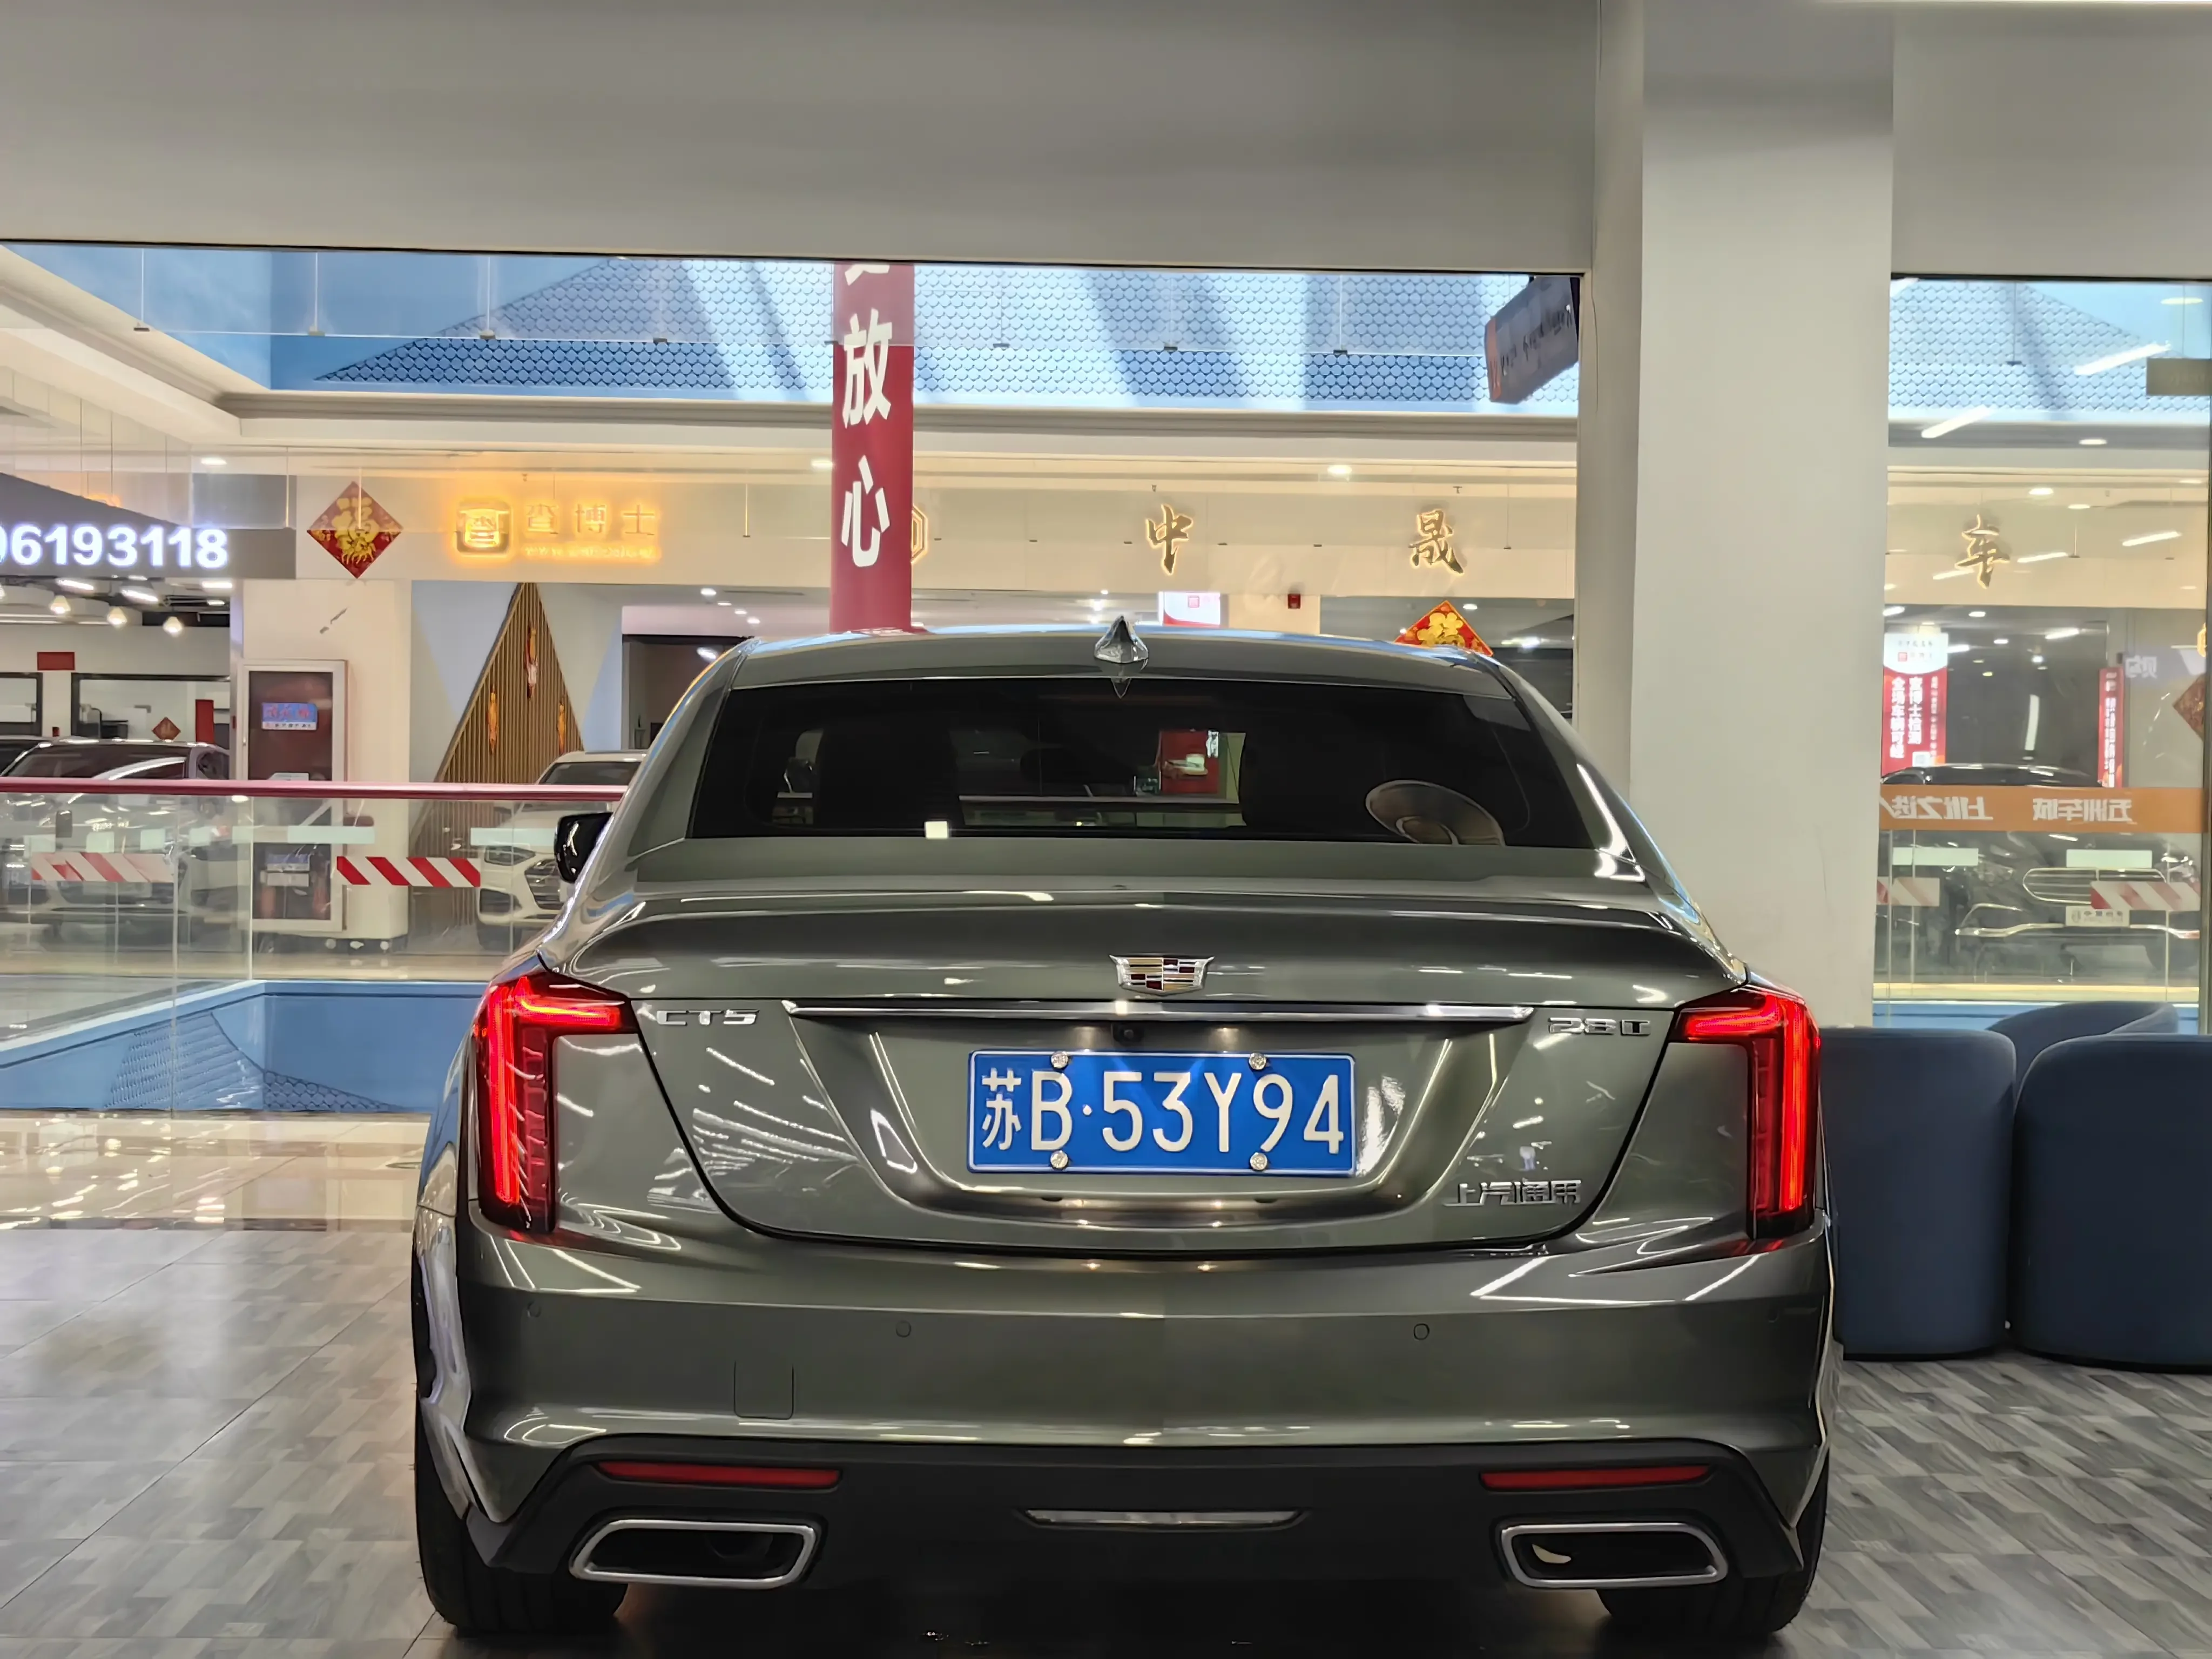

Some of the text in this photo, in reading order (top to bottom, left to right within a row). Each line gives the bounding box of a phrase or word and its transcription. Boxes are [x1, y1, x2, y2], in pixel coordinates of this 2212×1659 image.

[841, 265, 894, 568] 放心
[0, 524, 227, 568] 6193118
[657, 1009, 759, 1026] CT5
[1548, 1017, 1651, 1036] 28T
[1443, 1177, 1582, 1208] 上汽通用
